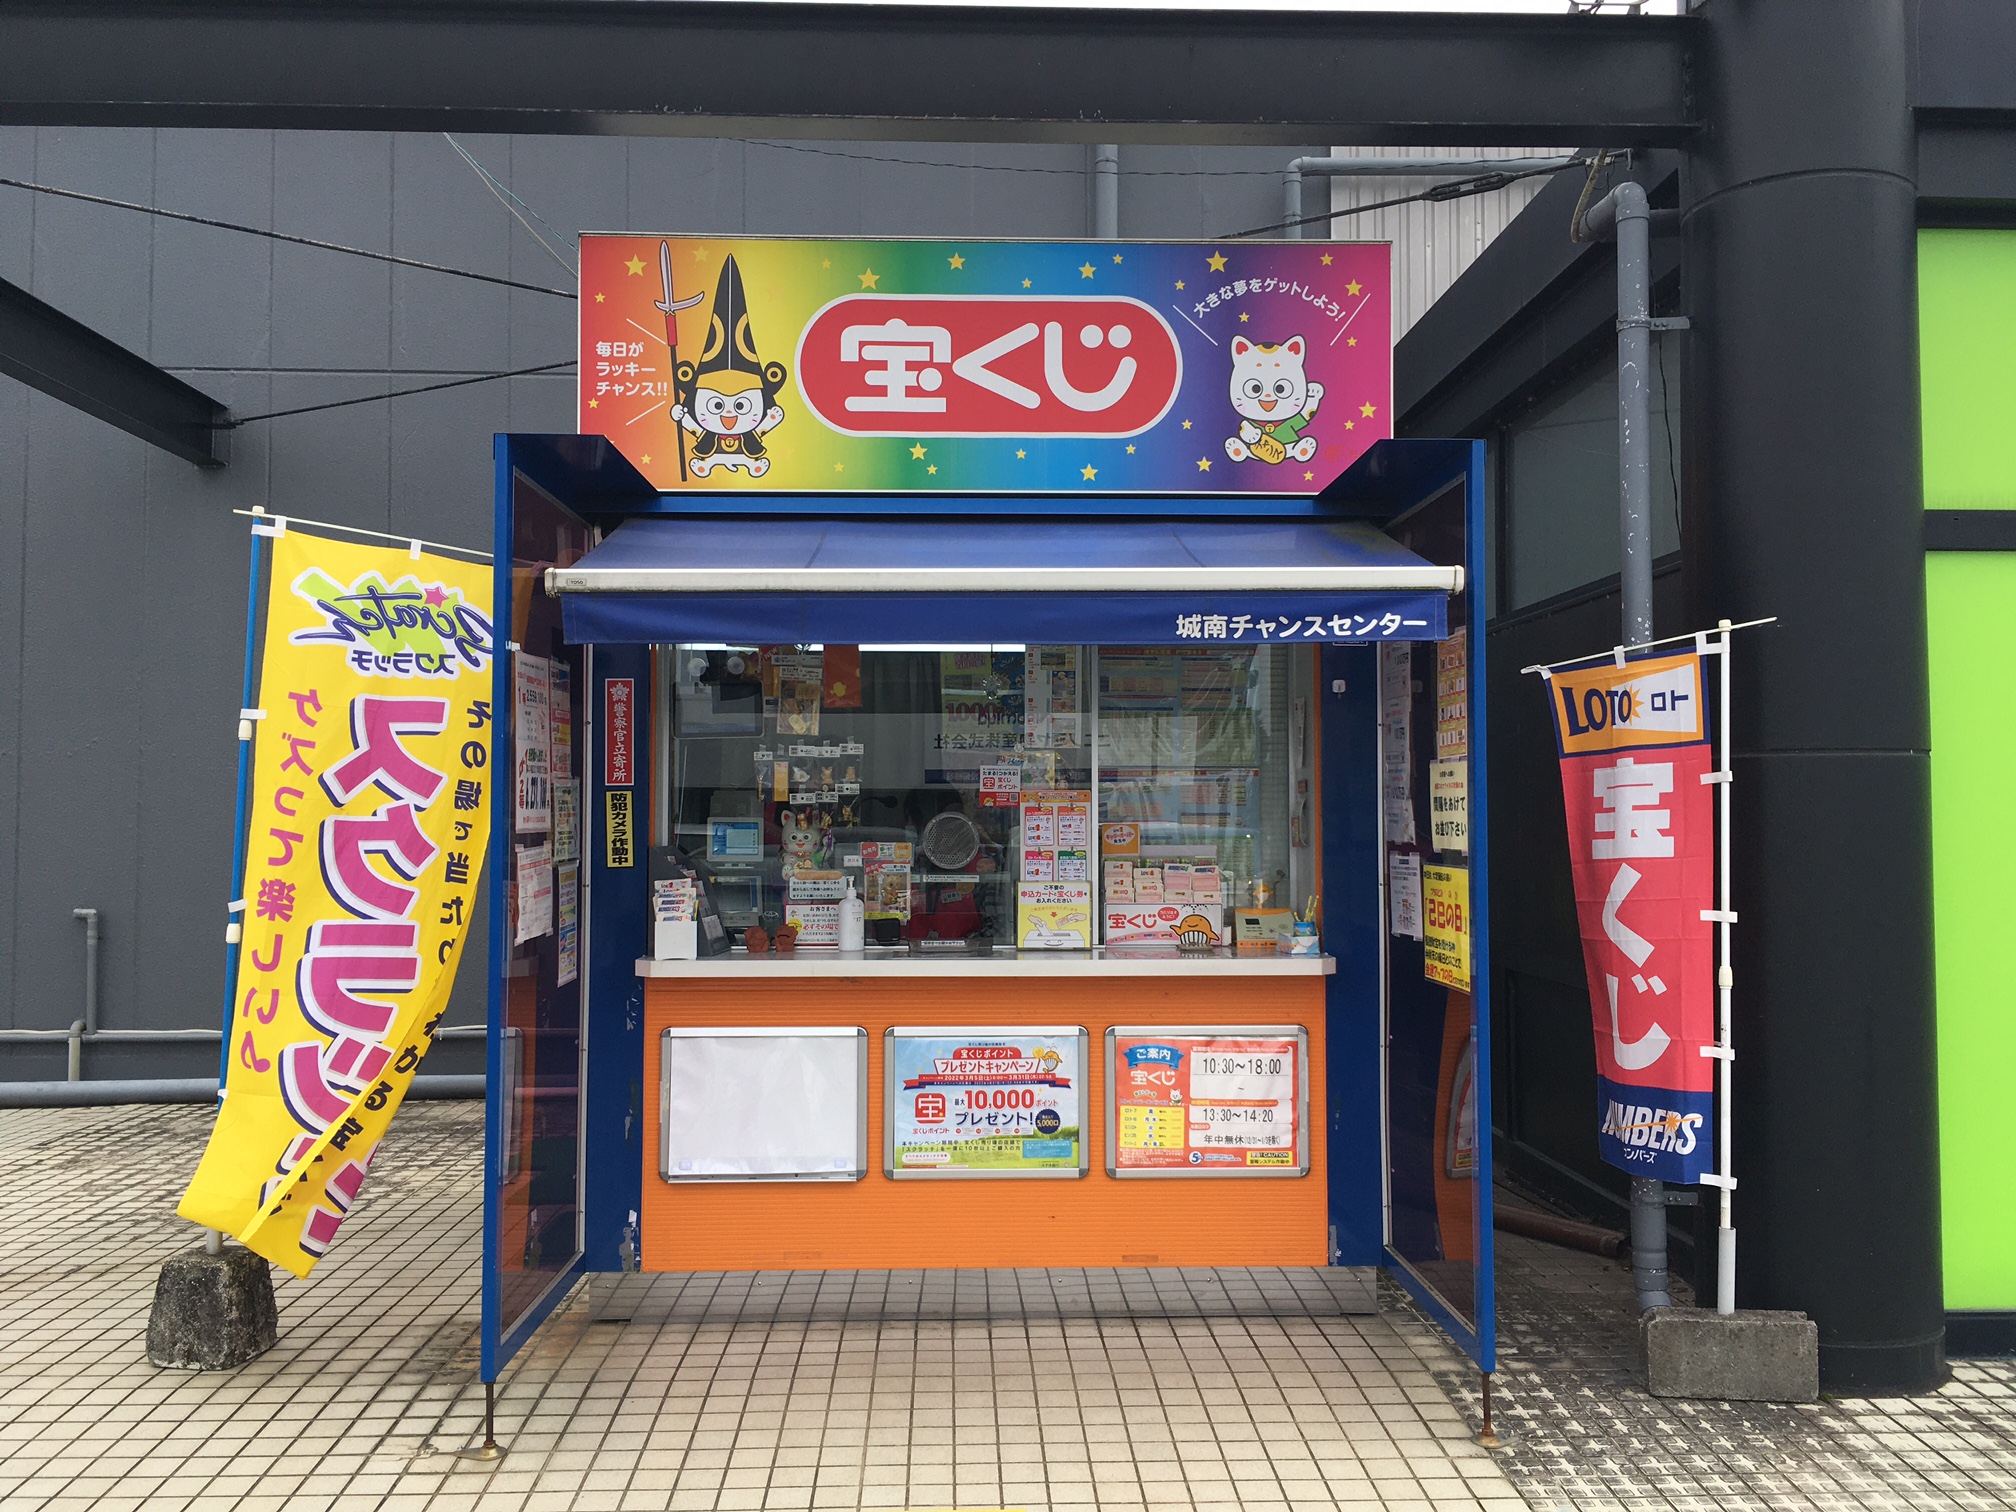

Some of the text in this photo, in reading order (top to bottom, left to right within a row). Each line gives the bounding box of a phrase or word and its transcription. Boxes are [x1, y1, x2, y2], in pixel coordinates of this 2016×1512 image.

[1192, 277, 1347, 323] 大きな夢をゲットしよう!
[595, 341, 644, 359] 毎日が
[596, 362, 656, 378] ラッキー
[840, 318, 1137, 413] 宝くじ
[596, 380, 668, 398] チャンス!!
[1176, 614, 1428, 639] 城南チャンスセンター
[1651, 690, 1689, 711] ロト
[1559, 687, 1632, 737] LOTO
[612, 702, 628, 782] 警察官立寄所
[1433, 796, 1466, 812] 間隔をあけて
[610, 793, 629, 866] 防犯カメラ作動中
[1435, 821, 1467, 837] お並び下さい
[1108, 912, 1158, 929] 宝くじ
[1591, 757, 1675, 1071] 宝くじ
[960, 1049, 1014, 1059] 宝くじポイント
[1136, 1048, 1171, 1060] ご案内
[940, 1061, 1034, 1074] プレゼントキャンペーン
[1130, 1070, 1176, 1086] 宝くじ
[964, 1089, 1034, 1110] 10,000
[1035, 1099, 1058, 1107] ポイント
[955, 1112, 1033, 1126] プレゼント!
[912, 1127, 950, 1135] 宝くじポイント
